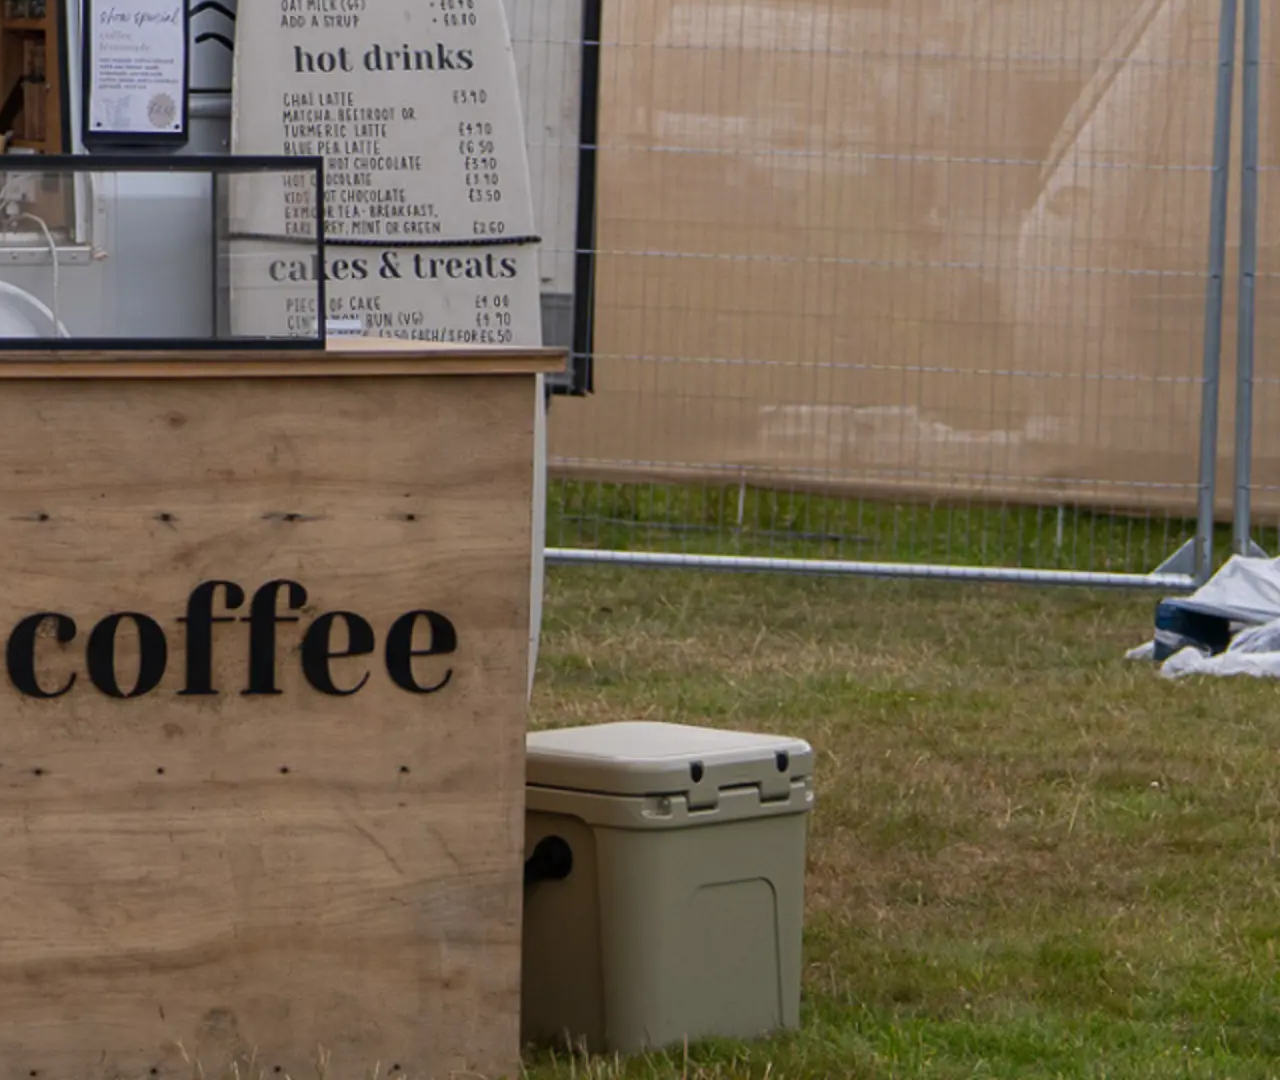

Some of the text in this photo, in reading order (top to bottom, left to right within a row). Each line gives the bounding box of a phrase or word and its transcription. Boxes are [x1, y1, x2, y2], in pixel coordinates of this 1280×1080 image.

[281, 14, 306, 27] ADD
[312, 14, 320, 27] A
[324, 14, 360, 28] SYRUP
[294, 44, 474, 72] hot drinks
[283, 93, 314, 106] CHAI
[320, 92, 353, 106] LATTE
[338, 107, 396, 121] BEETROOT
[402, 107, 416, 119] OR
[284, 125, 346, 138] TURMERIC
[355, 124, 387, 137] LATTE
[284, 141, 312, 155] BLUE
[318, 141, 339, 154] PEA
[344, 141, 380, 154] LATTE
[329, 157, 351, 170] HOT
[354, 156, 422, 170] CHOCOLATE
[283, 175, 306, 188] HOT
[310, 174, 372, 186] COCOLATE
[340, 189, 405, 202] CHOCOLATE
[285, 206, 333, 219] EXMOR
[338, 205, 360, 218] TEA
[351, 221, 380, 233] MINT
[386, 221, 400, 233] OR
[403, 222, 440, 234] GREEN
[269, 251, 517, 282] cakes & treats
[286, 298, 324, 311] PIEC
[329, 298, 344, 311] OF
[349, 296, 381, 311] CAKE
[366, 313, 392, 328] BUN
[5, 579, 459, 700] coffee
